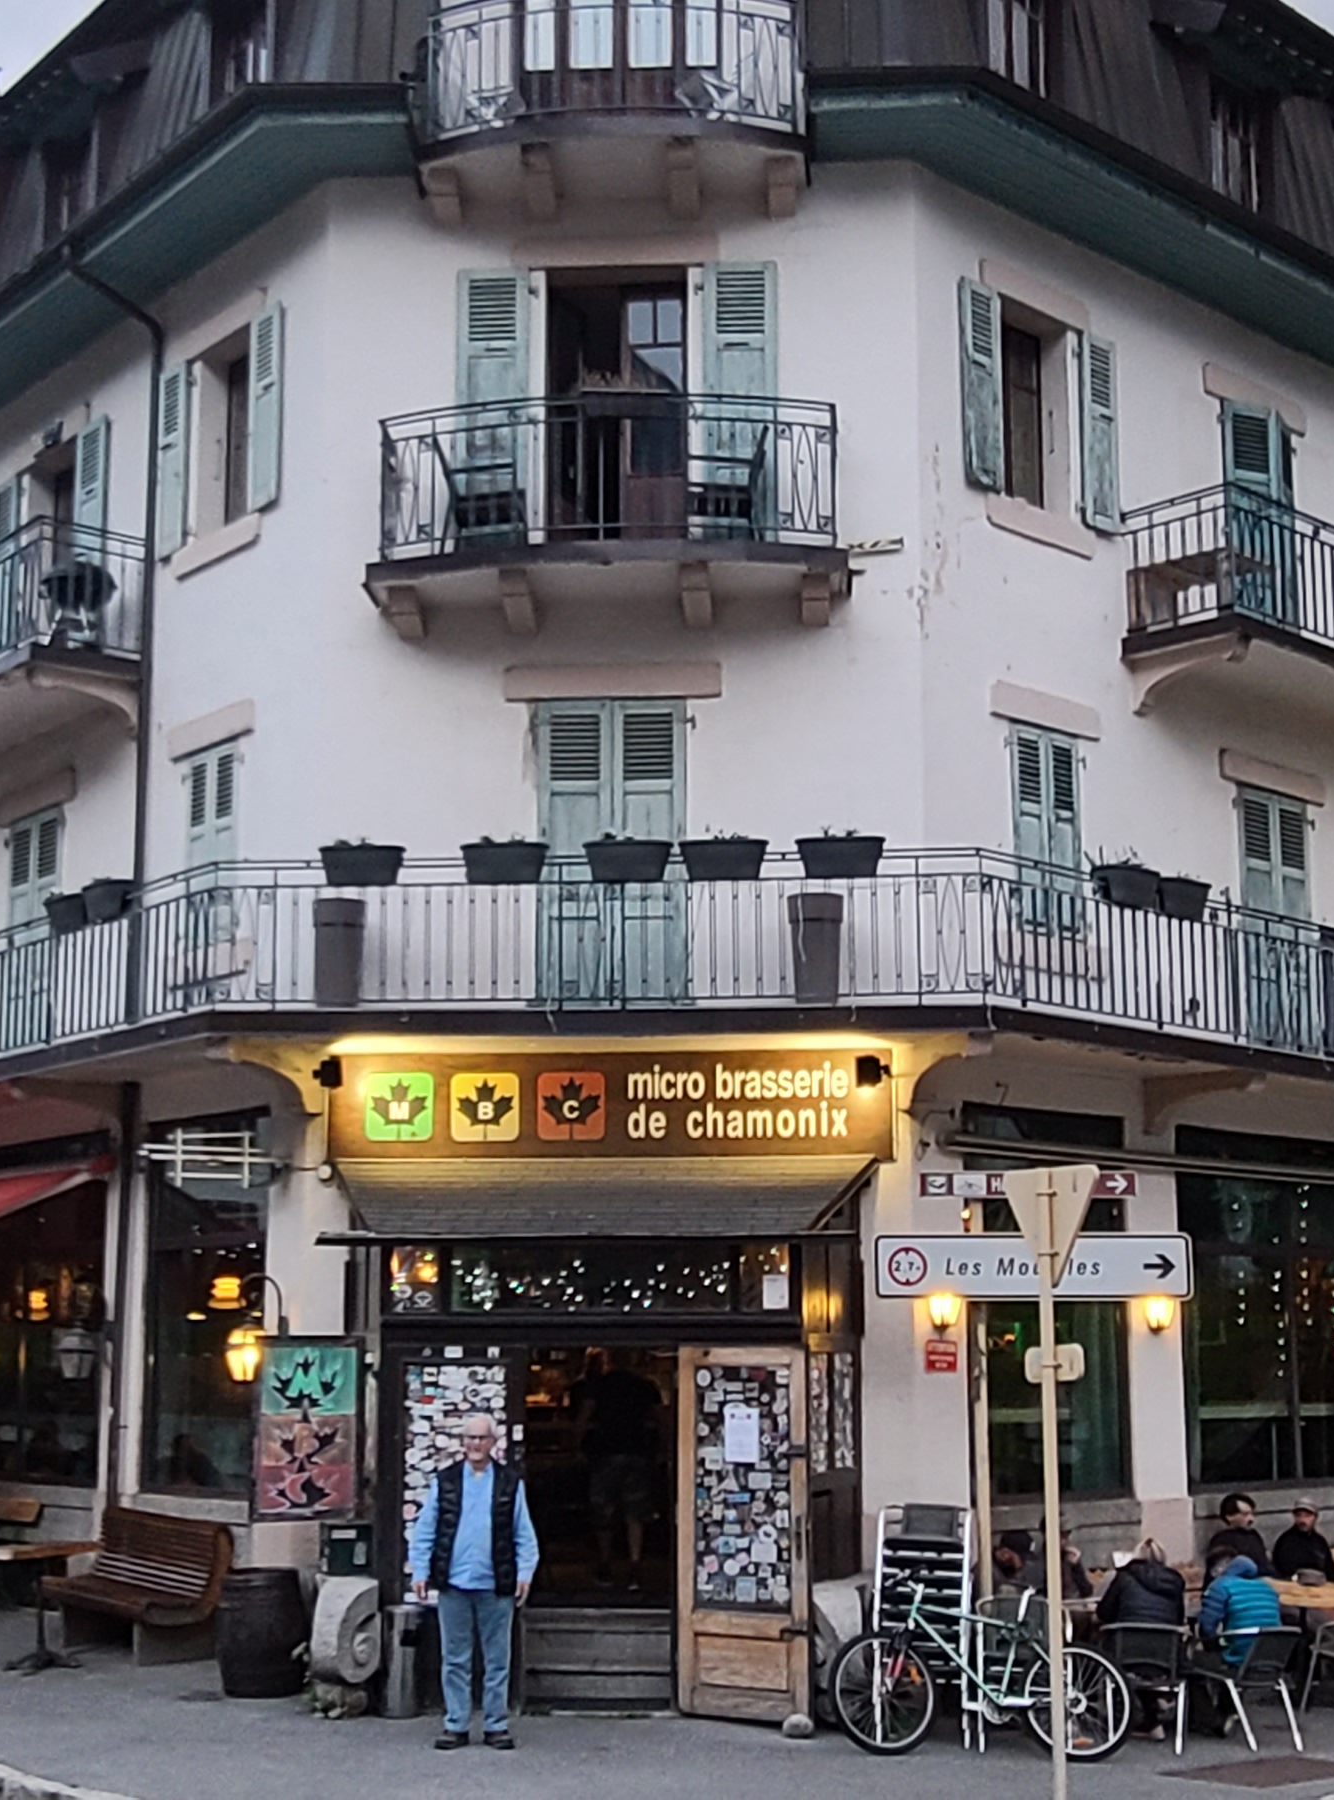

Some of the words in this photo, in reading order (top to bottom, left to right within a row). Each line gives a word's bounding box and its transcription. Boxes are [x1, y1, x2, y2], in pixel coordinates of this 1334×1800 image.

[627, 1064, 706, 1100] micro
[715, 1060, 850, 1099] brasserie
[388, 1101, 410, 1120] M
[477, 1101, 495, 1120] B
[562, 1100, 581, 1119] C
[627, 1102, 667, 1139] de
[686, 1100, 848, 1139] chamonix
[945, 1257, 982, 1276] Les
[996, 1257, 1101, 1276] Moules
[285, 1366, 326, 1399] M
